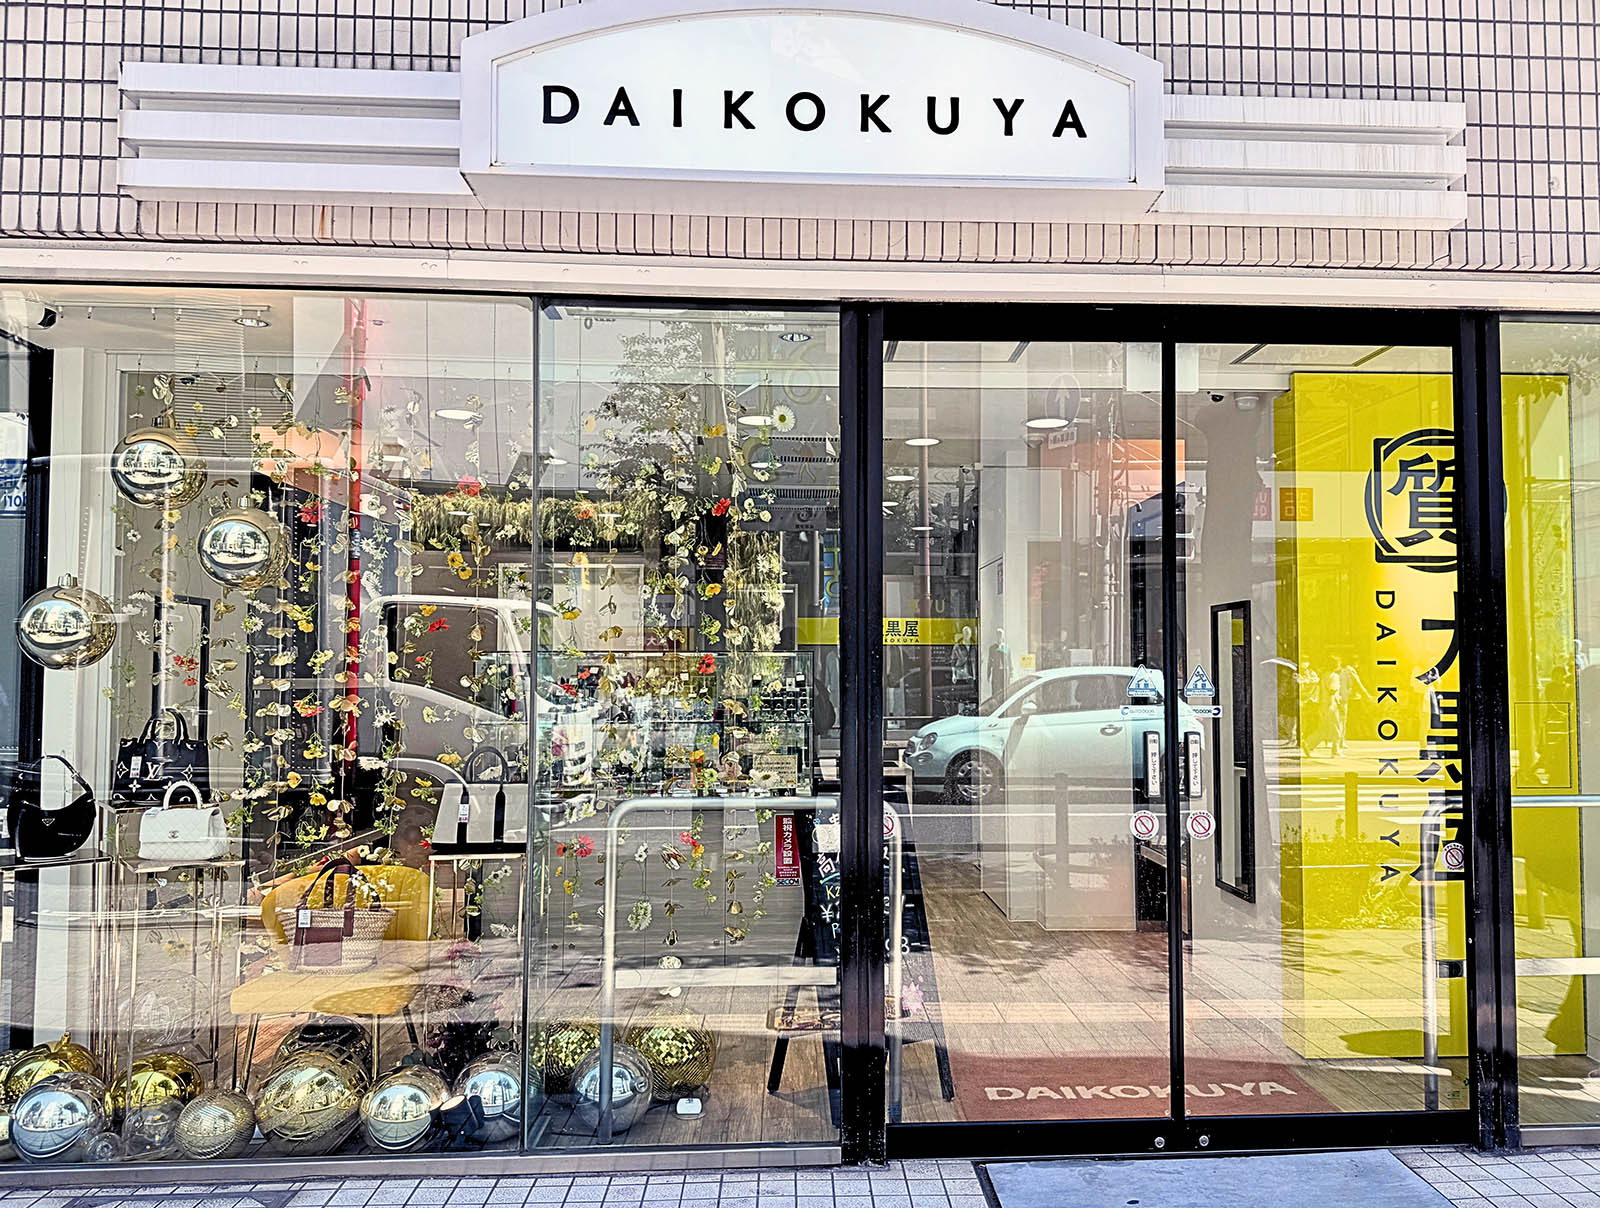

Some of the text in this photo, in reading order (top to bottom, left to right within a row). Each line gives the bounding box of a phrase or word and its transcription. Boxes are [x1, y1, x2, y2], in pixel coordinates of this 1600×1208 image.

[542, 85, 1087, 138] DAIKOKUYA
[883, 620, 920, 638] 黒屋
[1375, 589, 1400, 882] DAIKOKUYA
[782, 817, 793, 865] 監視カメラ設置
